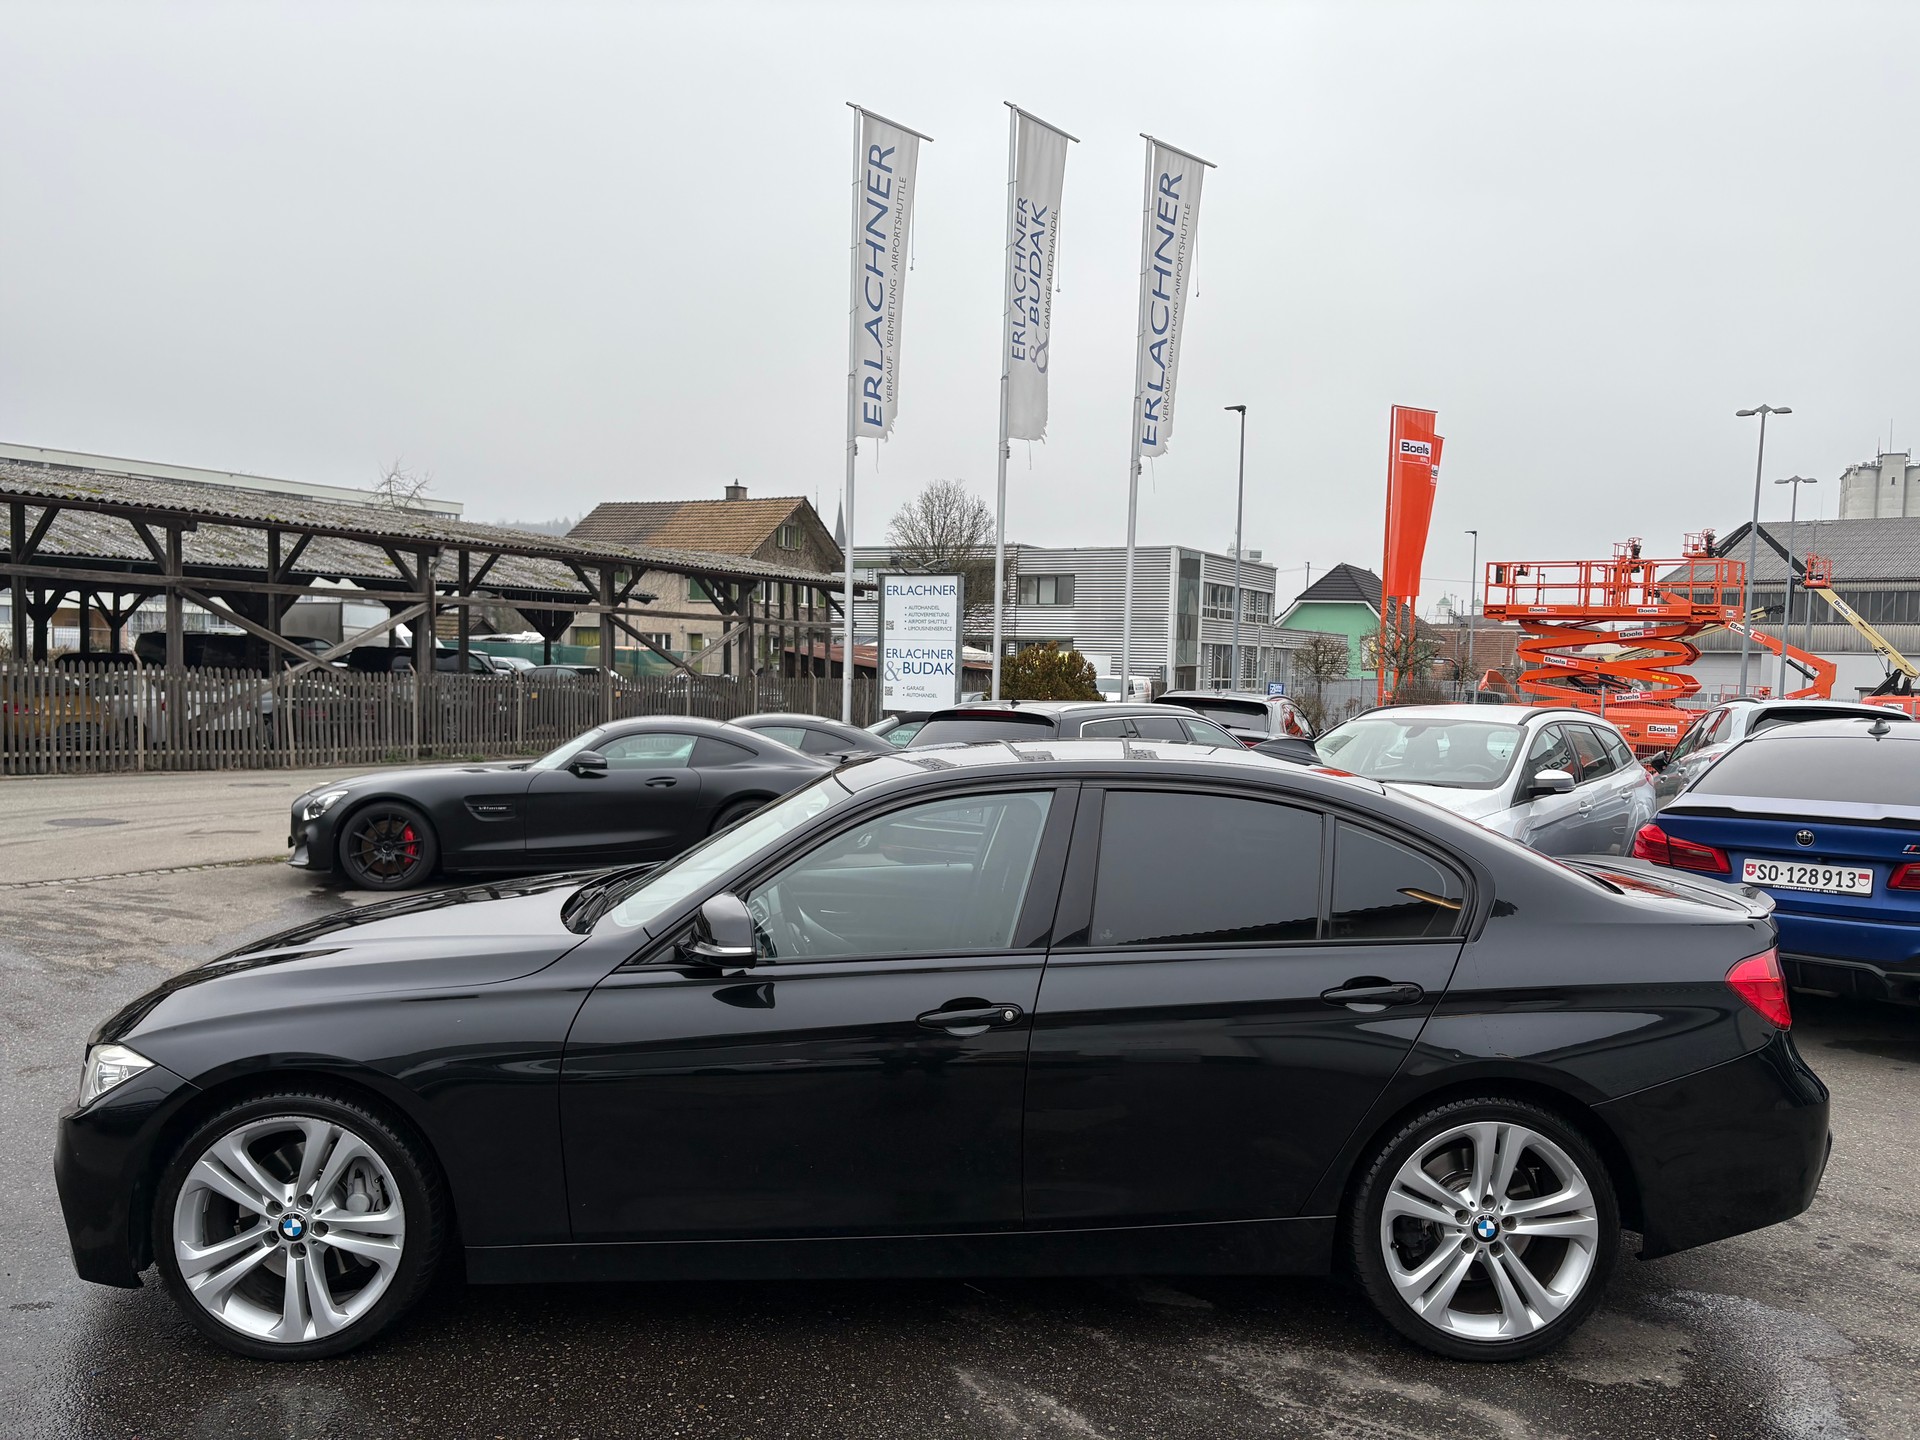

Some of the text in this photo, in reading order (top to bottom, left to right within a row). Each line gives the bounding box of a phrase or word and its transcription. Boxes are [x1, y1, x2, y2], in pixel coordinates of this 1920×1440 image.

[863, 144, 895, 427] ERLACHNER
[886, 176, 907, 403] VERKAUF VERMIETUNG AIRPORTSHUTTLE
[1011, 197, 1028, 361] ERLACHNER
[1029, 201, 1048, 374] & BUDAK
[1044, 209, 1059, 330] GARAGE AUTOHANDEL
[1142, 172, 1183, 446] ERLACHNER
[1162, 202, 1191, 422] VERKAUF VERMIETUNG AIRPORTSHUTTLE
[1401, 441, 1430, 455] Boels
[886, 585, 957, 596] ERLACHNER
[886, 648, 954, 660] ERLACHNER
[884, 660, 955, 682] & BUDAK
[1648, 725, 1677, 733] Boels
